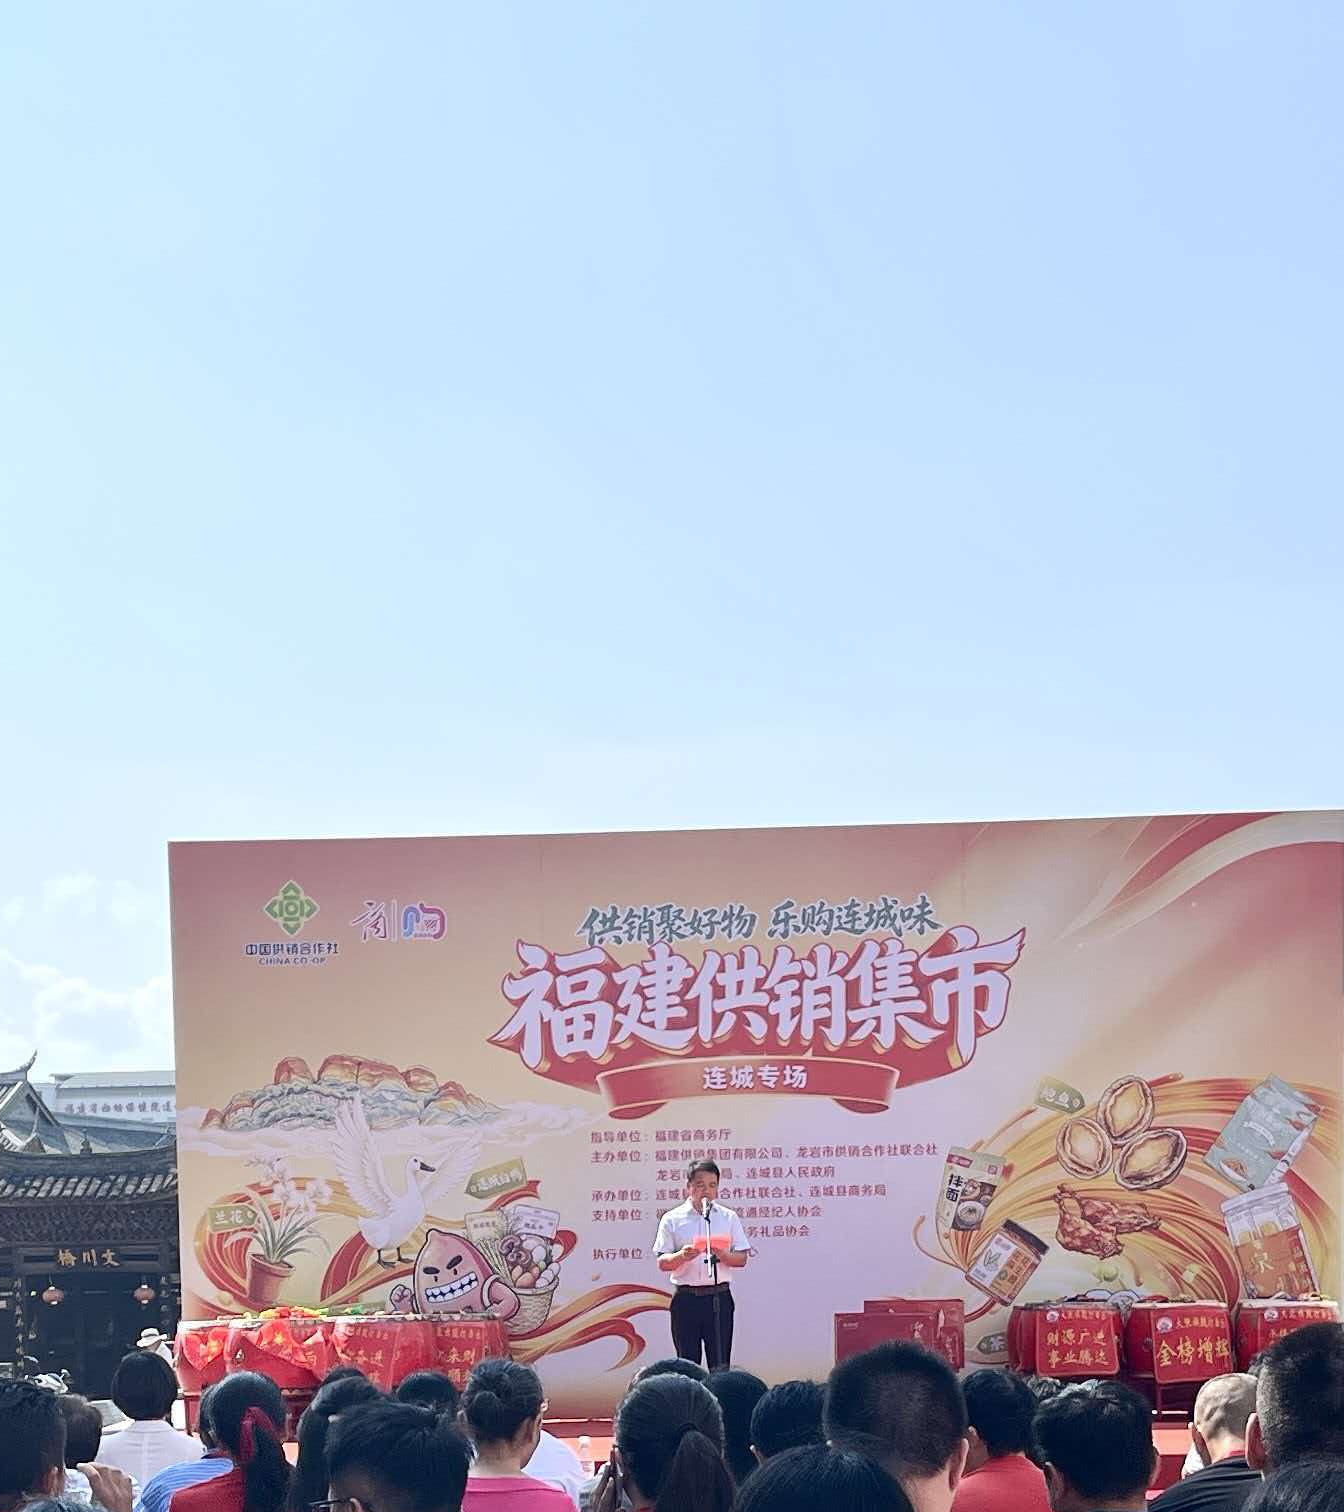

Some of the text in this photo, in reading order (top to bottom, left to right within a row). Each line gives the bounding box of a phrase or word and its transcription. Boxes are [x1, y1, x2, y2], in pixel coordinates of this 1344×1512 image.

[579, 894, 944, 946] 供销聚好物 乐购连城味
[245, 942, 339, 956] 中国供销合作社
[258, 957, 291, 966] CHINA
[493, 925, 1025, 1070] 福建供销集市
[702, 1064, 808, 1090] 连城专场
[214, 1209, 244, 1224] 兰花
